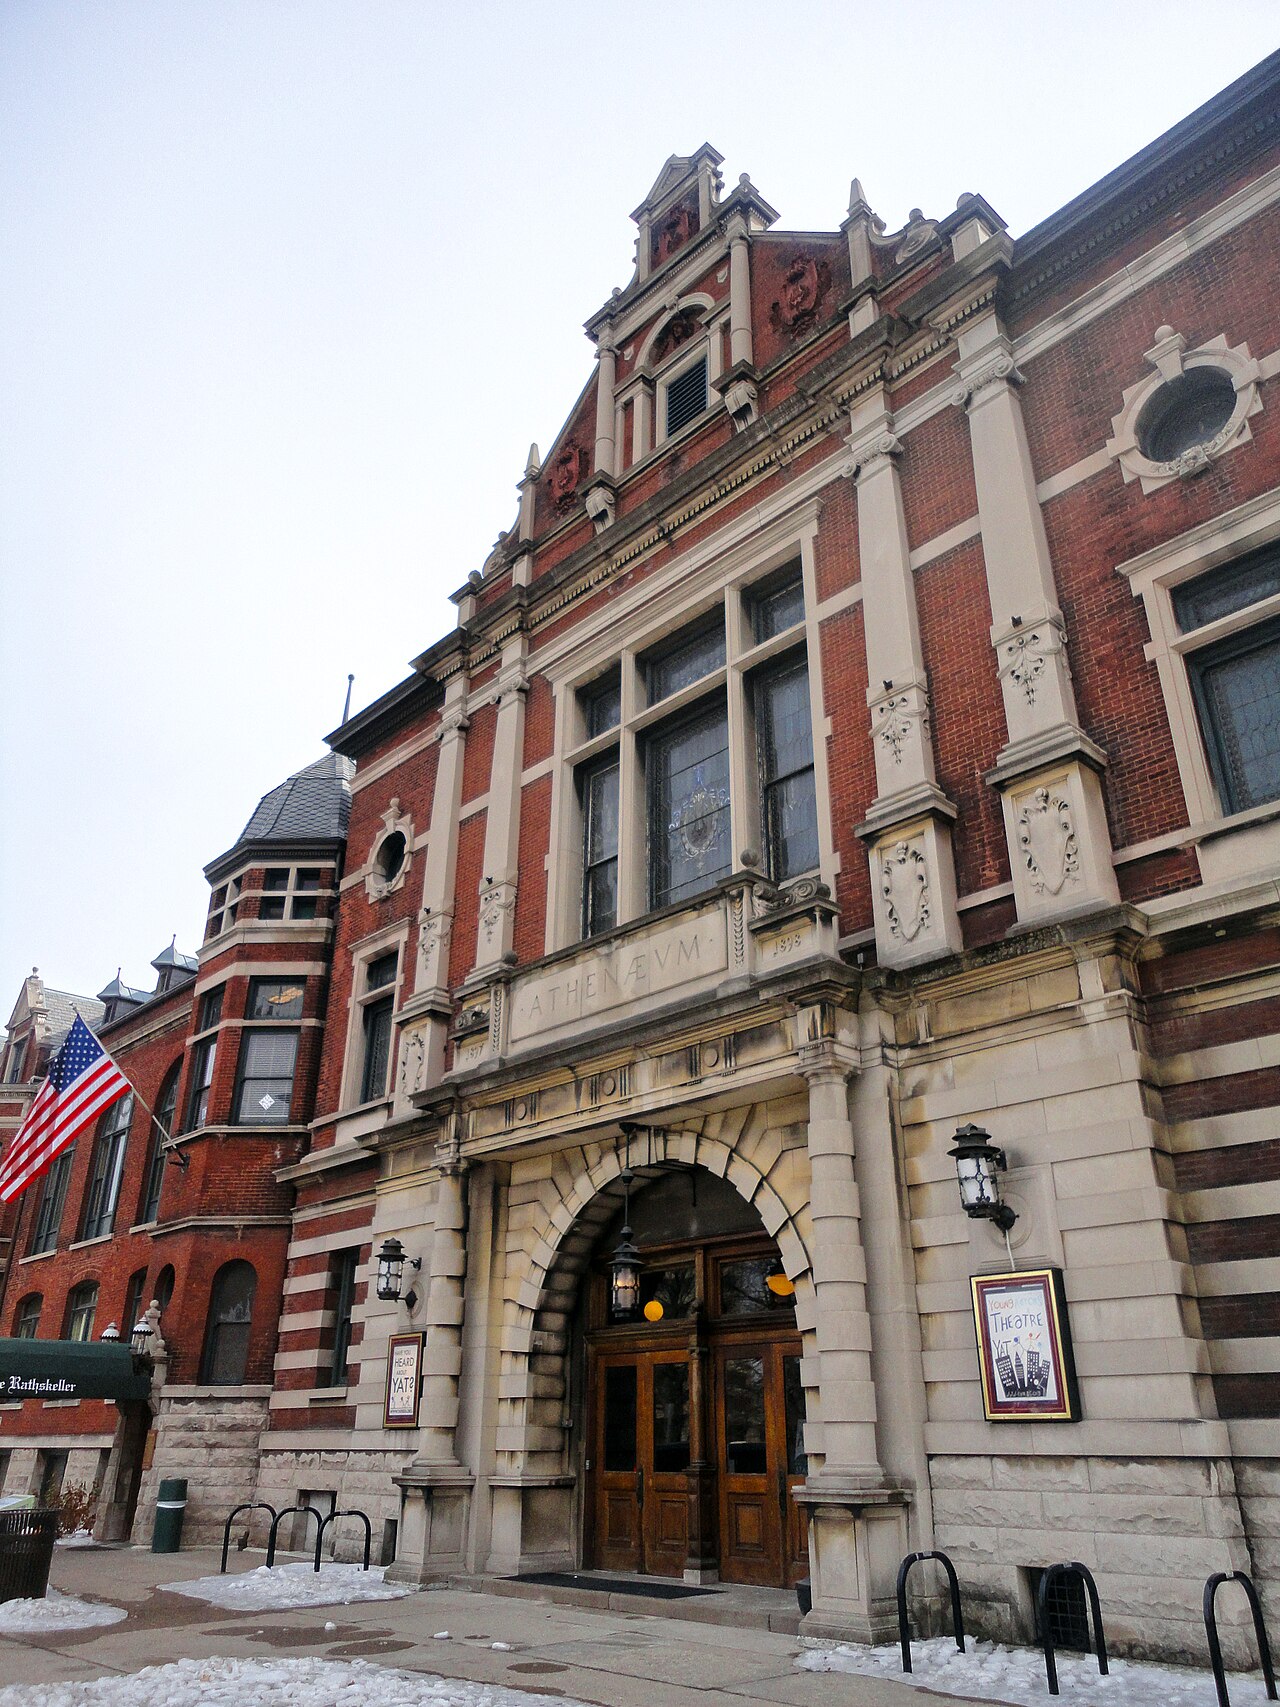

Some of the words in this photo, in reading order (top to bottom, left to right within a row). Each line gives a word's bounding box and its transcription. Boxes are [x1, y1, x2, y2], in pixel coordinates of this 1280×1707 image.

[988, 1298, 1014, 1311] YOUNG
[992, 1339, 1011, 1358] YAT
[395, 1357, 414, 1368] HEARD
[8, 1375, 76, 1394] Rathskeller
